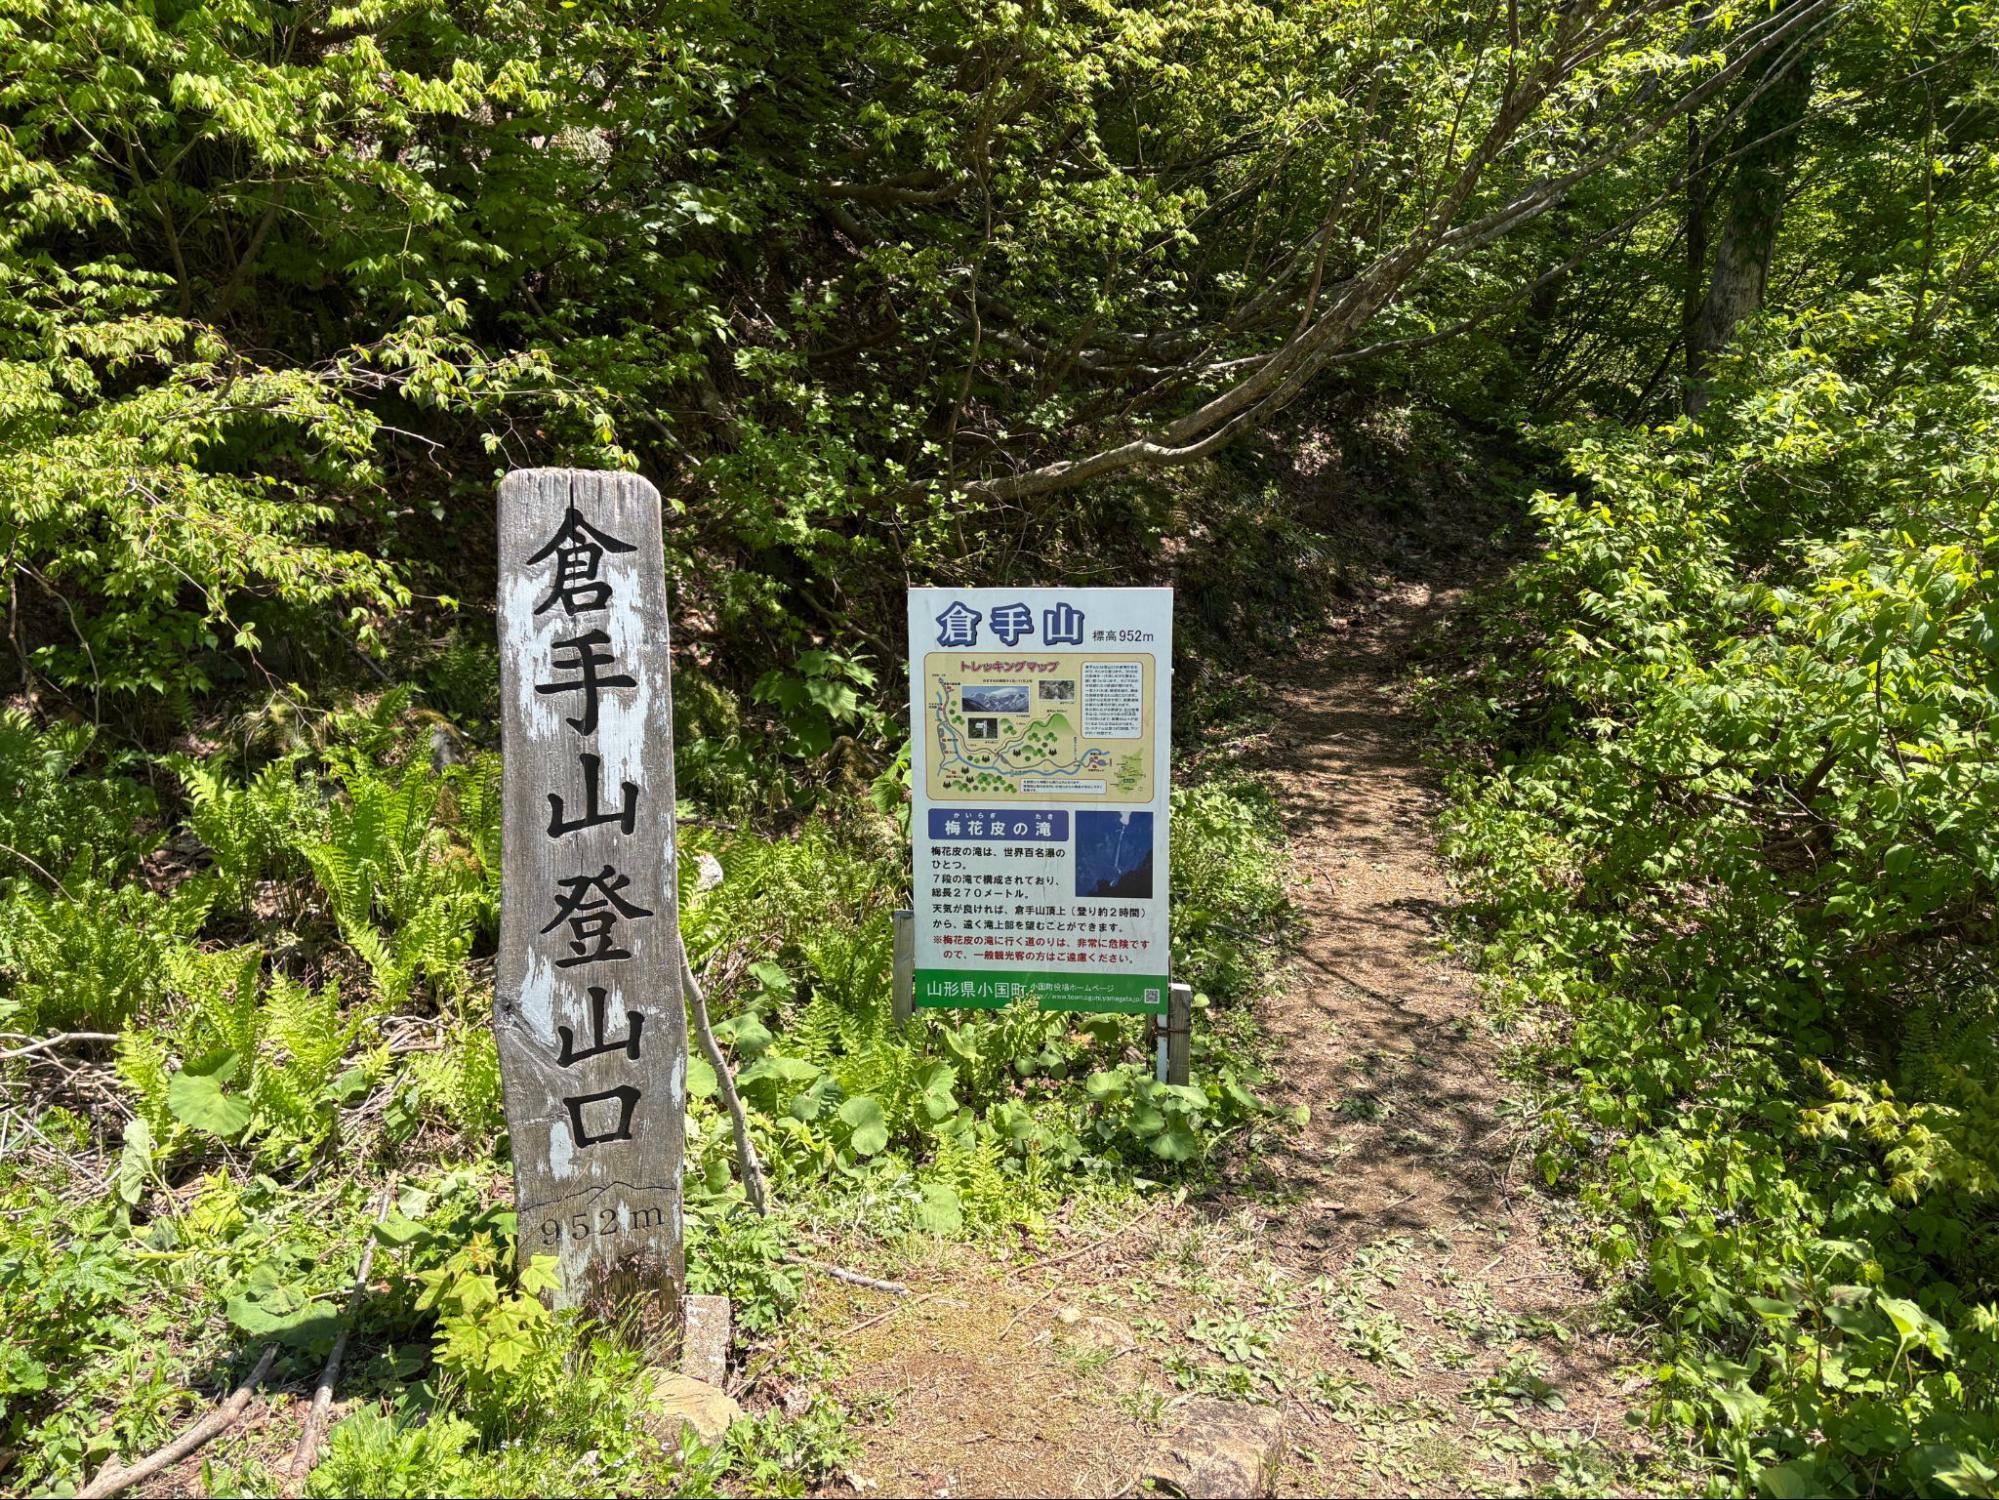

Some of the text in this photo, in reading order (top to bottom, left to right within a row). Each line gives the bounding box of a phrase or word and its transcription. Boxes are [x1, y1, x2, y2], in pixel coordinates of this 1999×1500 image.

[936, 601, 1154, 646] 倉手山 標高952m
[960, 660, 1060, 673] トレッキングマップ
[527, 508, 653, 1149] 倉手山登山口
[945, 820, 1052, 837] 梅花皮の滝
[932, 860, 967, 870] ひとつ。
[926, 980, 1027, 998] 山形県小国町
[541, 1205, 665, 1246] 952m
